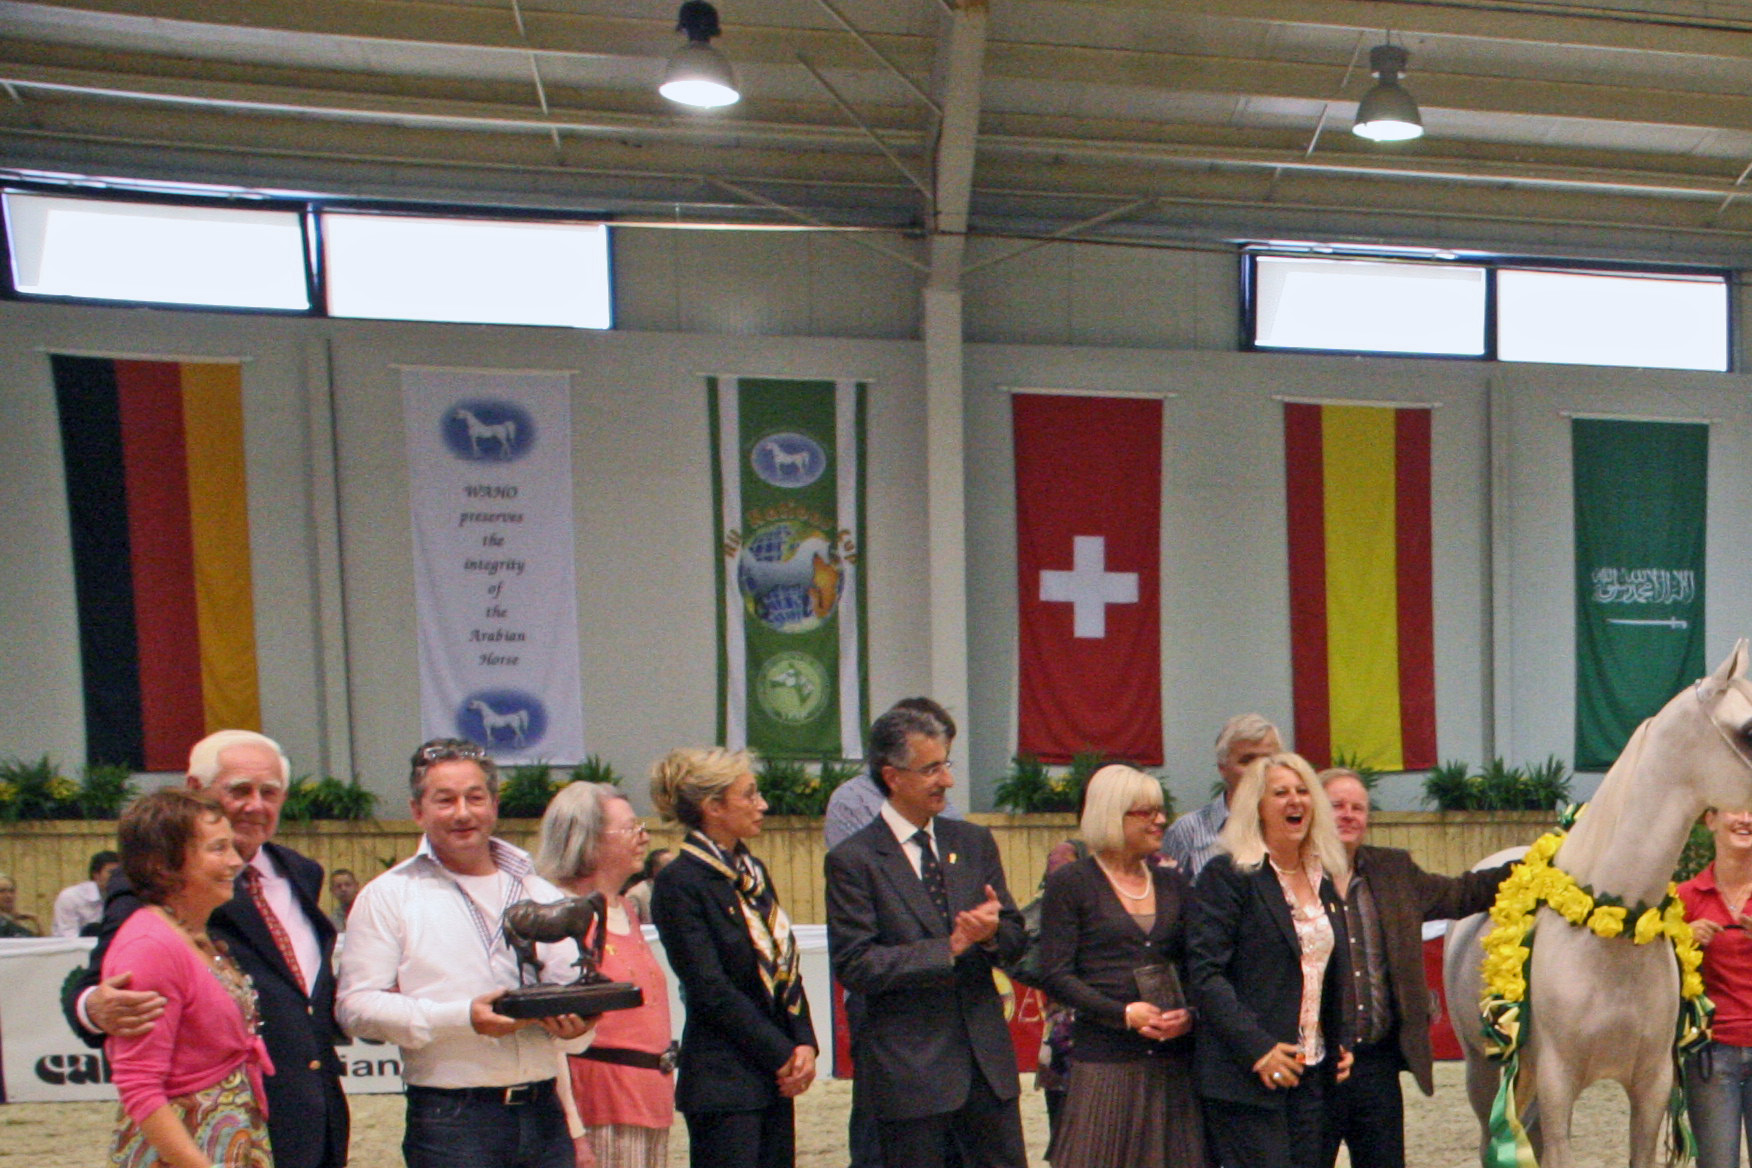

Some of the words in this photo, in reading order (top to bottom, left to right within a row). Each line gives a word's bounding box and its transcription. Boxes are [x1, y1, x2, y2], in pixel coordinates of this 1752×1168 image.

[459, 511, 523, 527] preserves
[482, 533, 505, 547] the
[463, 558, 525, 576] integrity
[487, 580, 504, 599] of
[486, 604, 508, 618] the
[468, 628, 526, 642] Arabian
[479, 652, 520, 666] Horse
